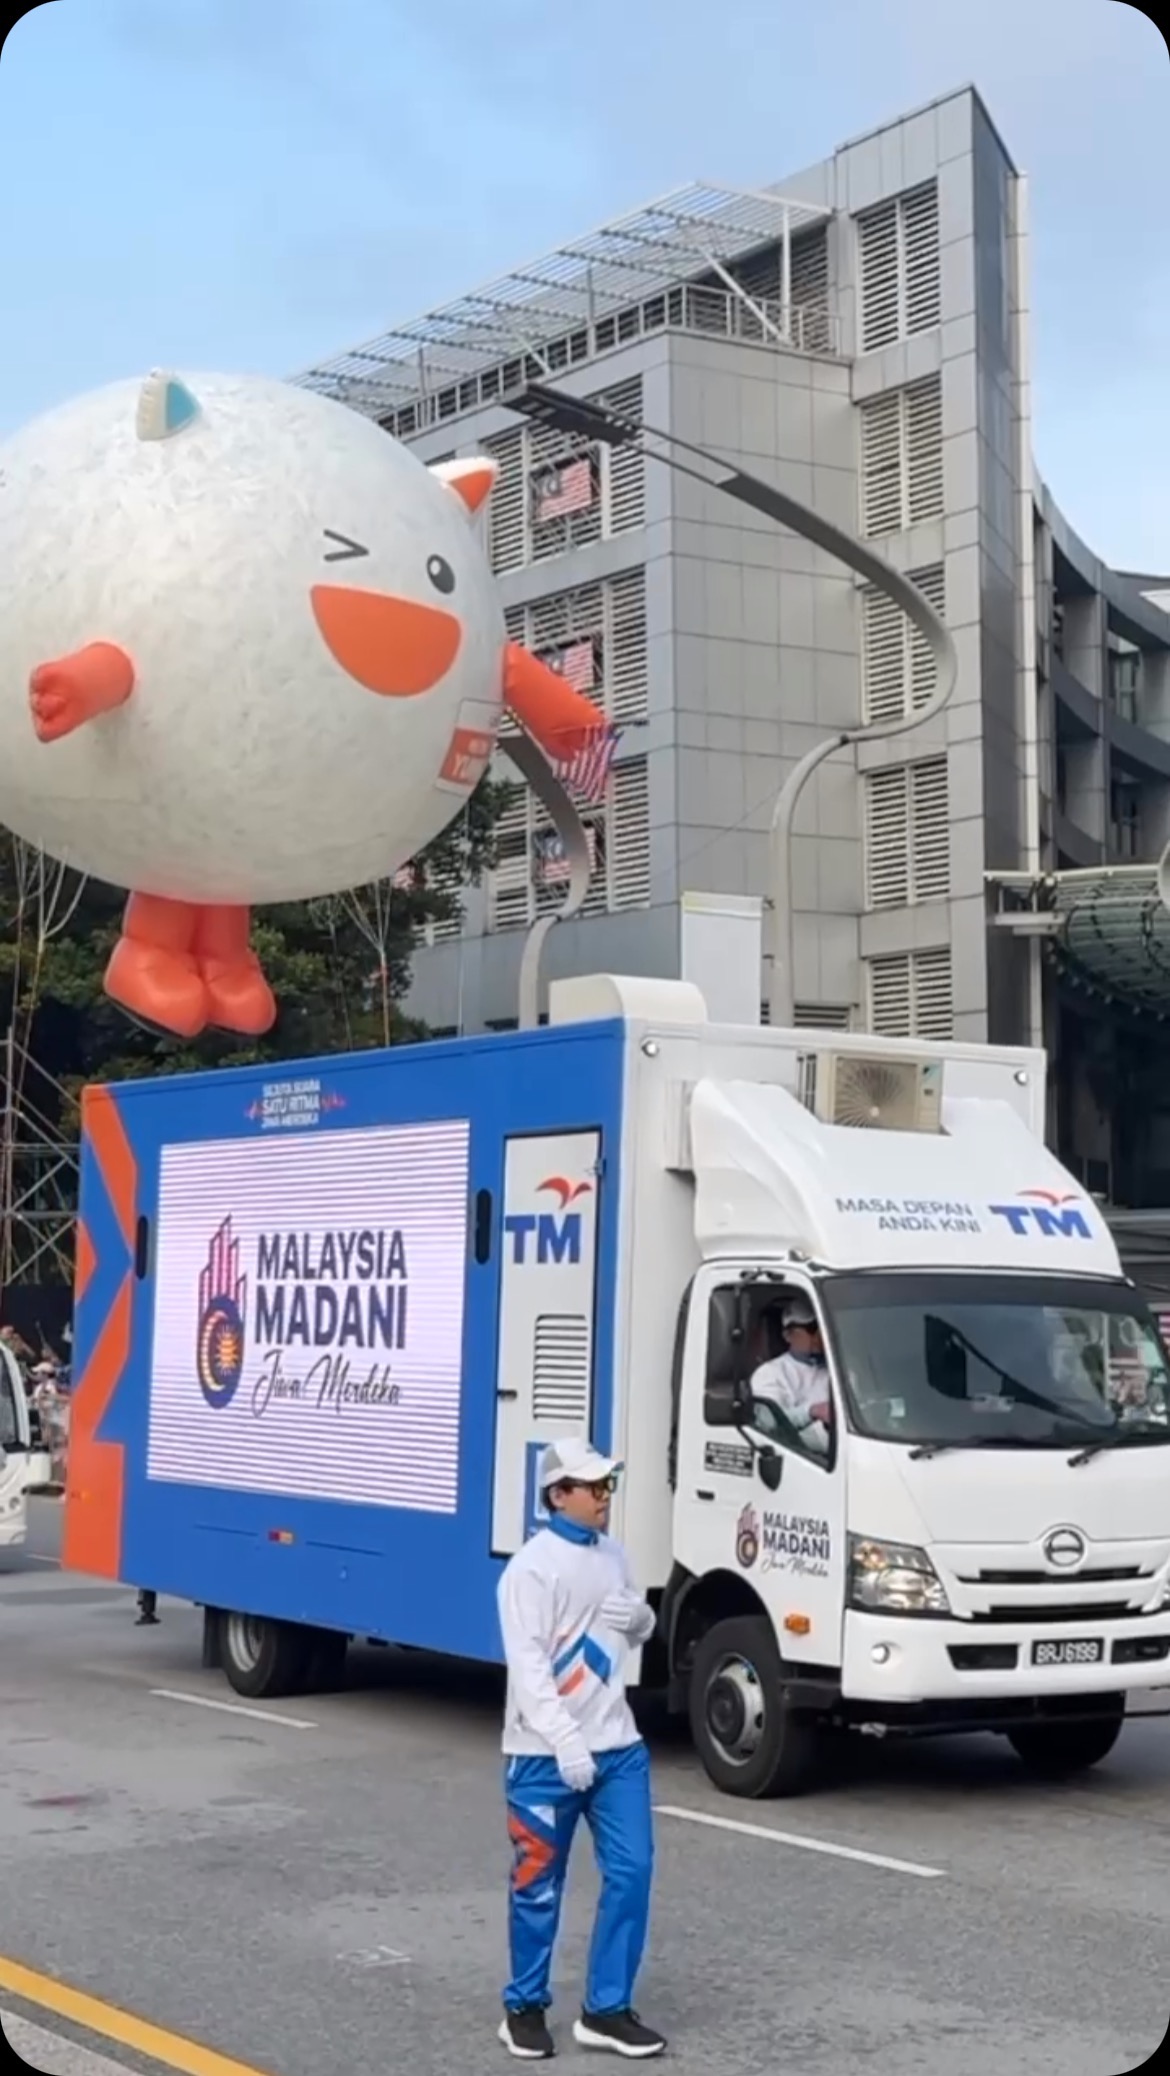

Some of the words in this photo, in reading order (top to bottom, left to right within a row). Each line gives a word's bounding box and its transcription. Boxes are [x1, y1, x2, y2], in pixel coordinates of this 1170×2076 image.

[262, 1097, 288, 1114] SATU
[835, 1198, 900, 1213] MASA
[903, 1200, 973, 1216] DEPAN
[988, 1205, 1092, 1239] TM
[505, 1213, 581, 1264] TM
[879, 1216, 938, 1232] ANDA
[940, 1218, 982, 1233] KINI
[256, 1230, 408, 1280] MALAYSIA
[255, 1285, 408, 1349] MADANI
[252, 1348, 301, 1418] Jiwa
[304, 1353, 401, 1414] Merdeka
[763, 1511, 830, 1537] MALAYSIA
[763, 1530, 831, 1561] MADANI
